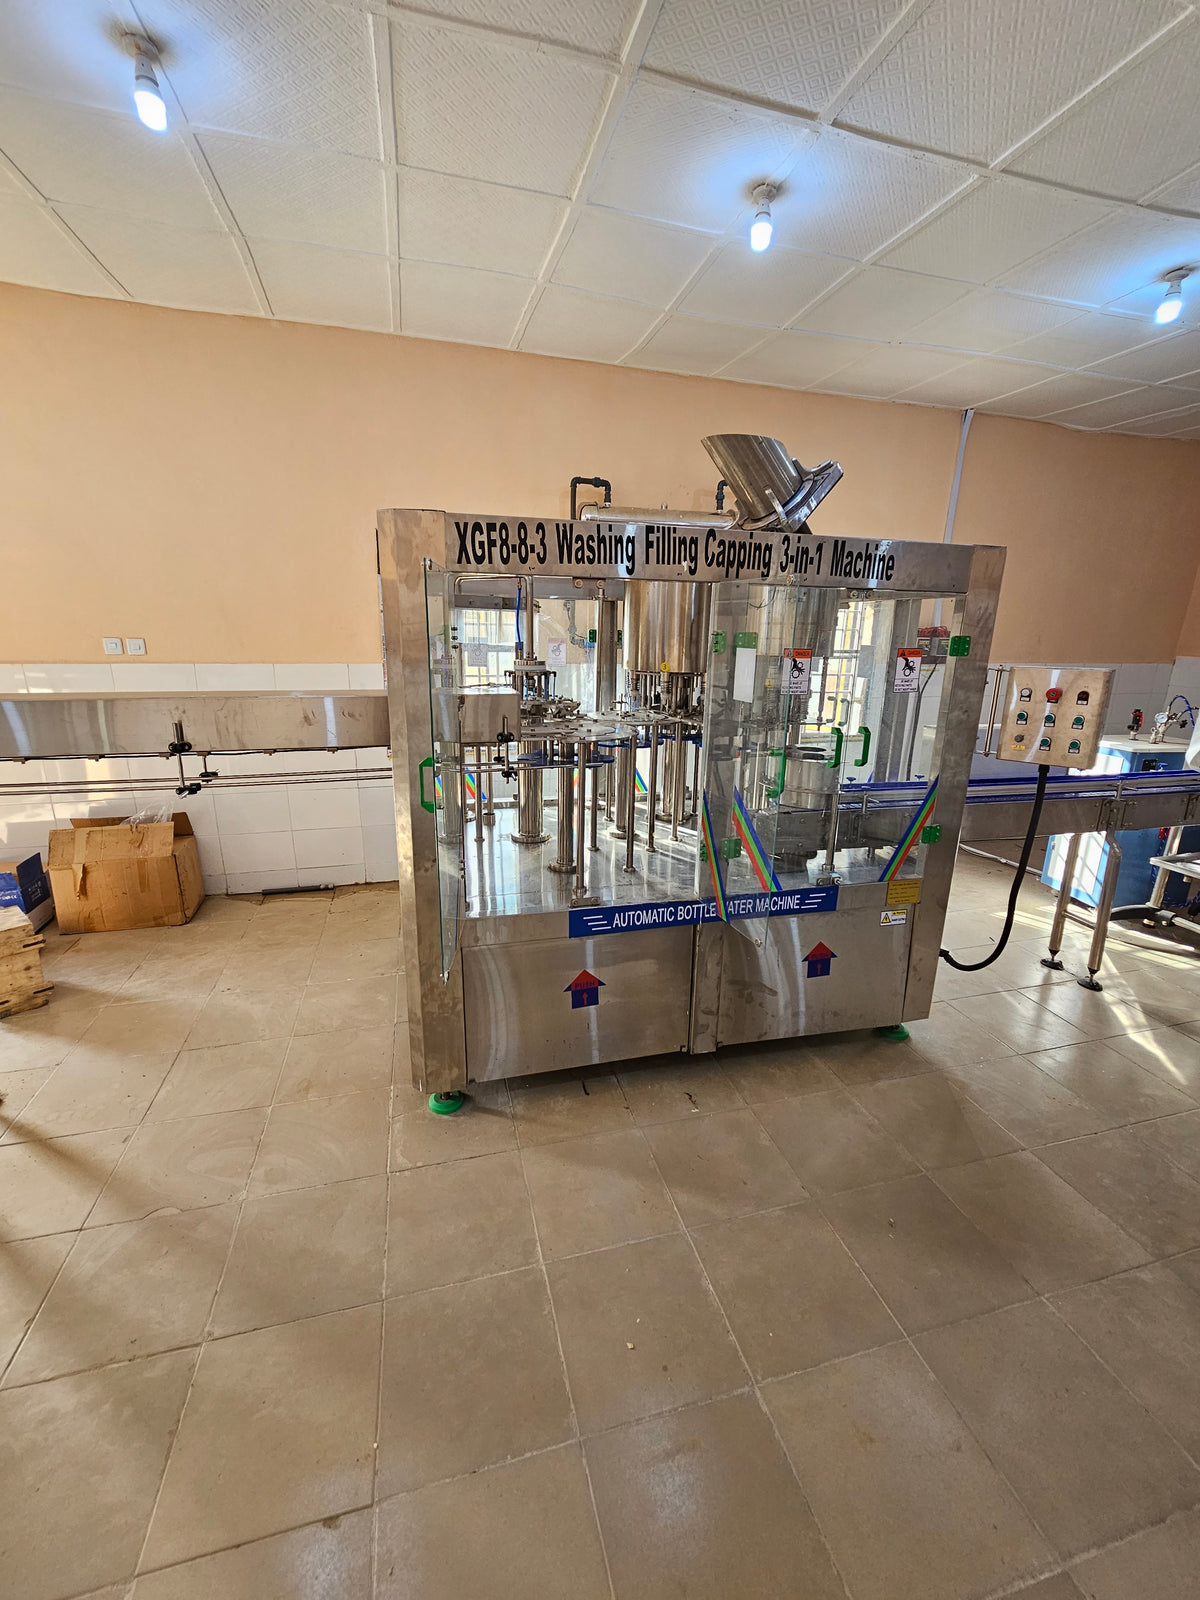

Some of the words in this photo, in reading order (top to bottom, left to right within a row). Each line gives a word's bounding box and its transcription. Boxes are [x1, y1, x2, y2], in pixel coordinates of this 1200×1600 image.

[454, 521, 548, 565] XGF8-8-3
[556, 523, 635, 576] Washing
[645, 525, 699, 576] Filling
[704, 528, 773, 578] Capping
[780, 534, 823, 575] 3-in-1
[830, 540, 895, 581] Machine
[612, 907, 675, 928] AUTOMATIC
[677, 902, 717, 921] BOTTLE
[726, 899, 754, 915] ATER
[755, 895, 801, 913] MACHINE
